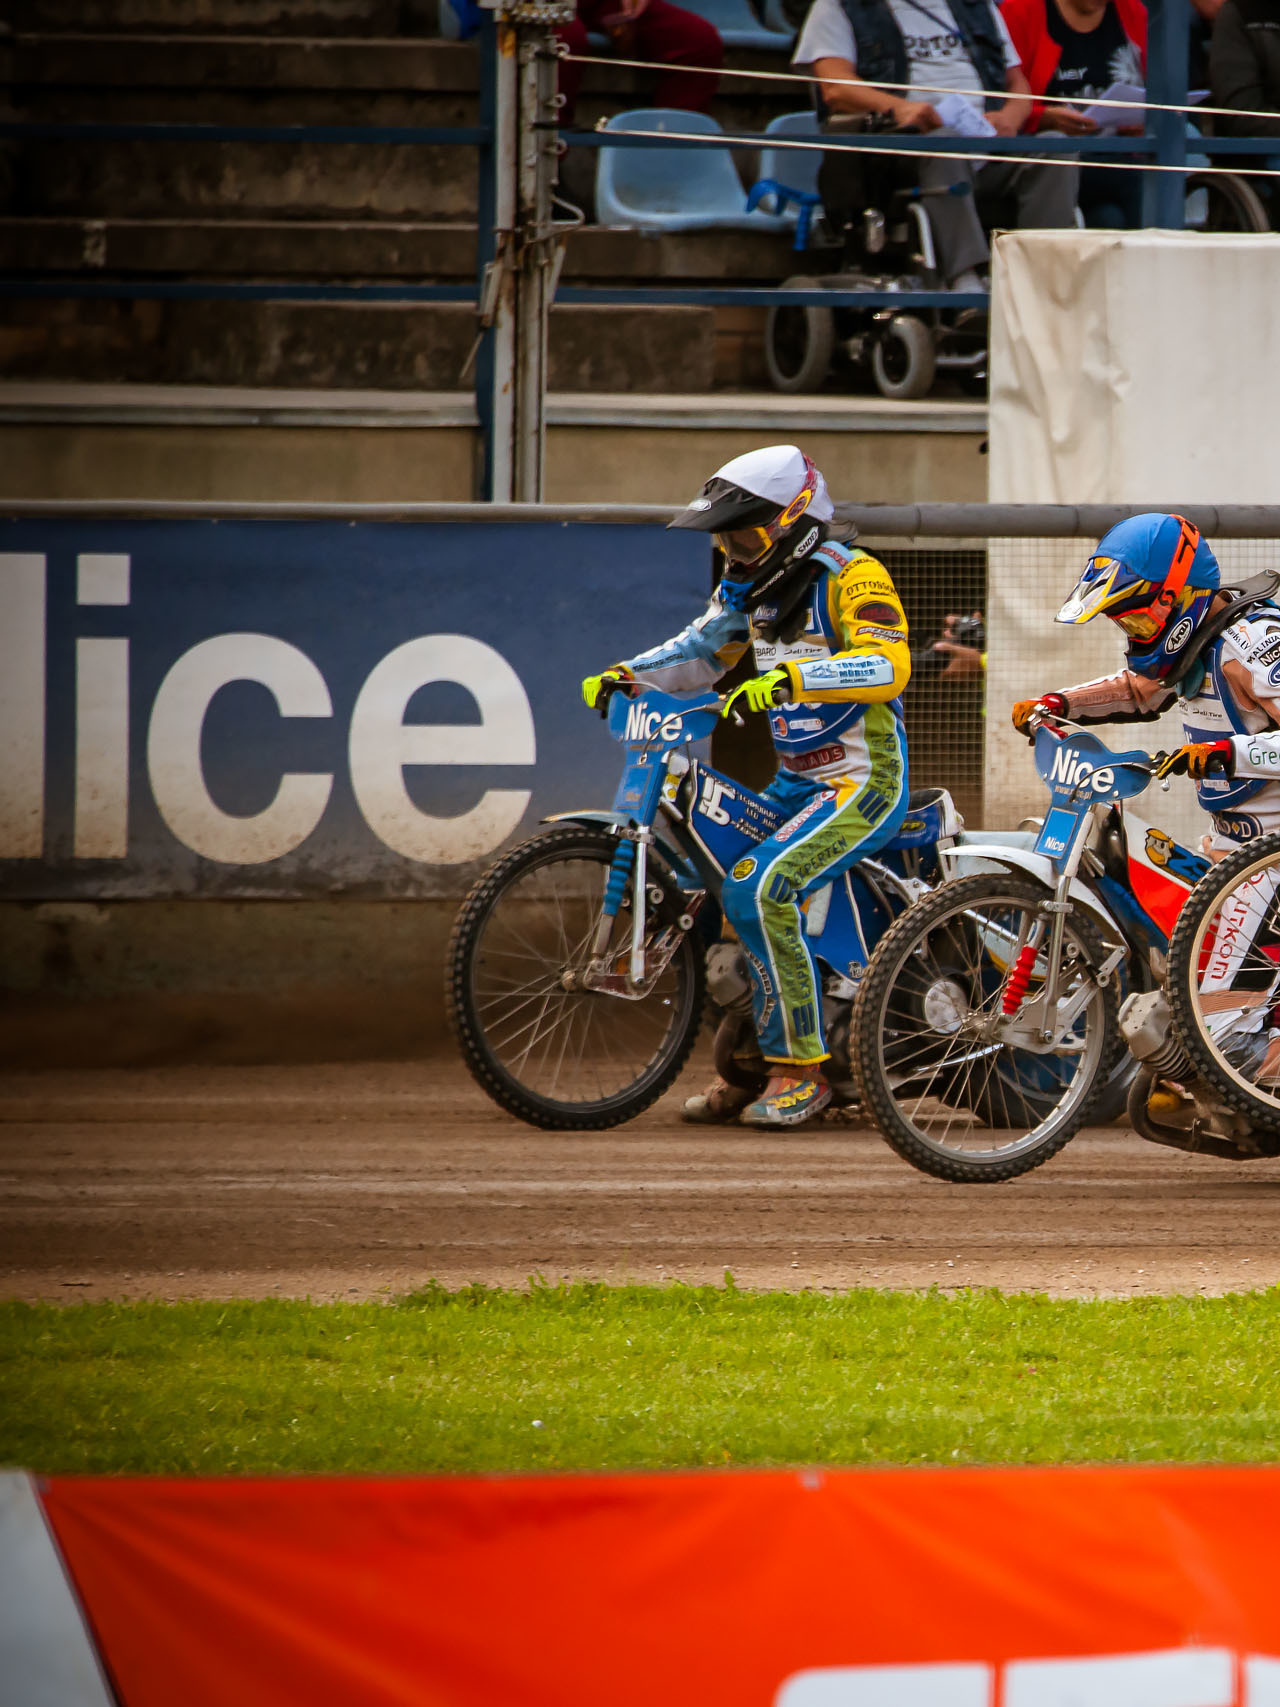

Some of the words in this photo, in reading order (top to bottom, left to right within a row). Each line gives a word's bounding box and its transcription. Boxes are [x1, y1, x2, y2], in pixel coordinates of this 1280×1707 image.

[1170, 622, 1190, 651] Arai
[0, 553, 536, 865] ice
[624, 701, 684, 742] Nice
[1050, 746, 1115, 793] Nice
[1045, 836, 1065, 852] Nice
